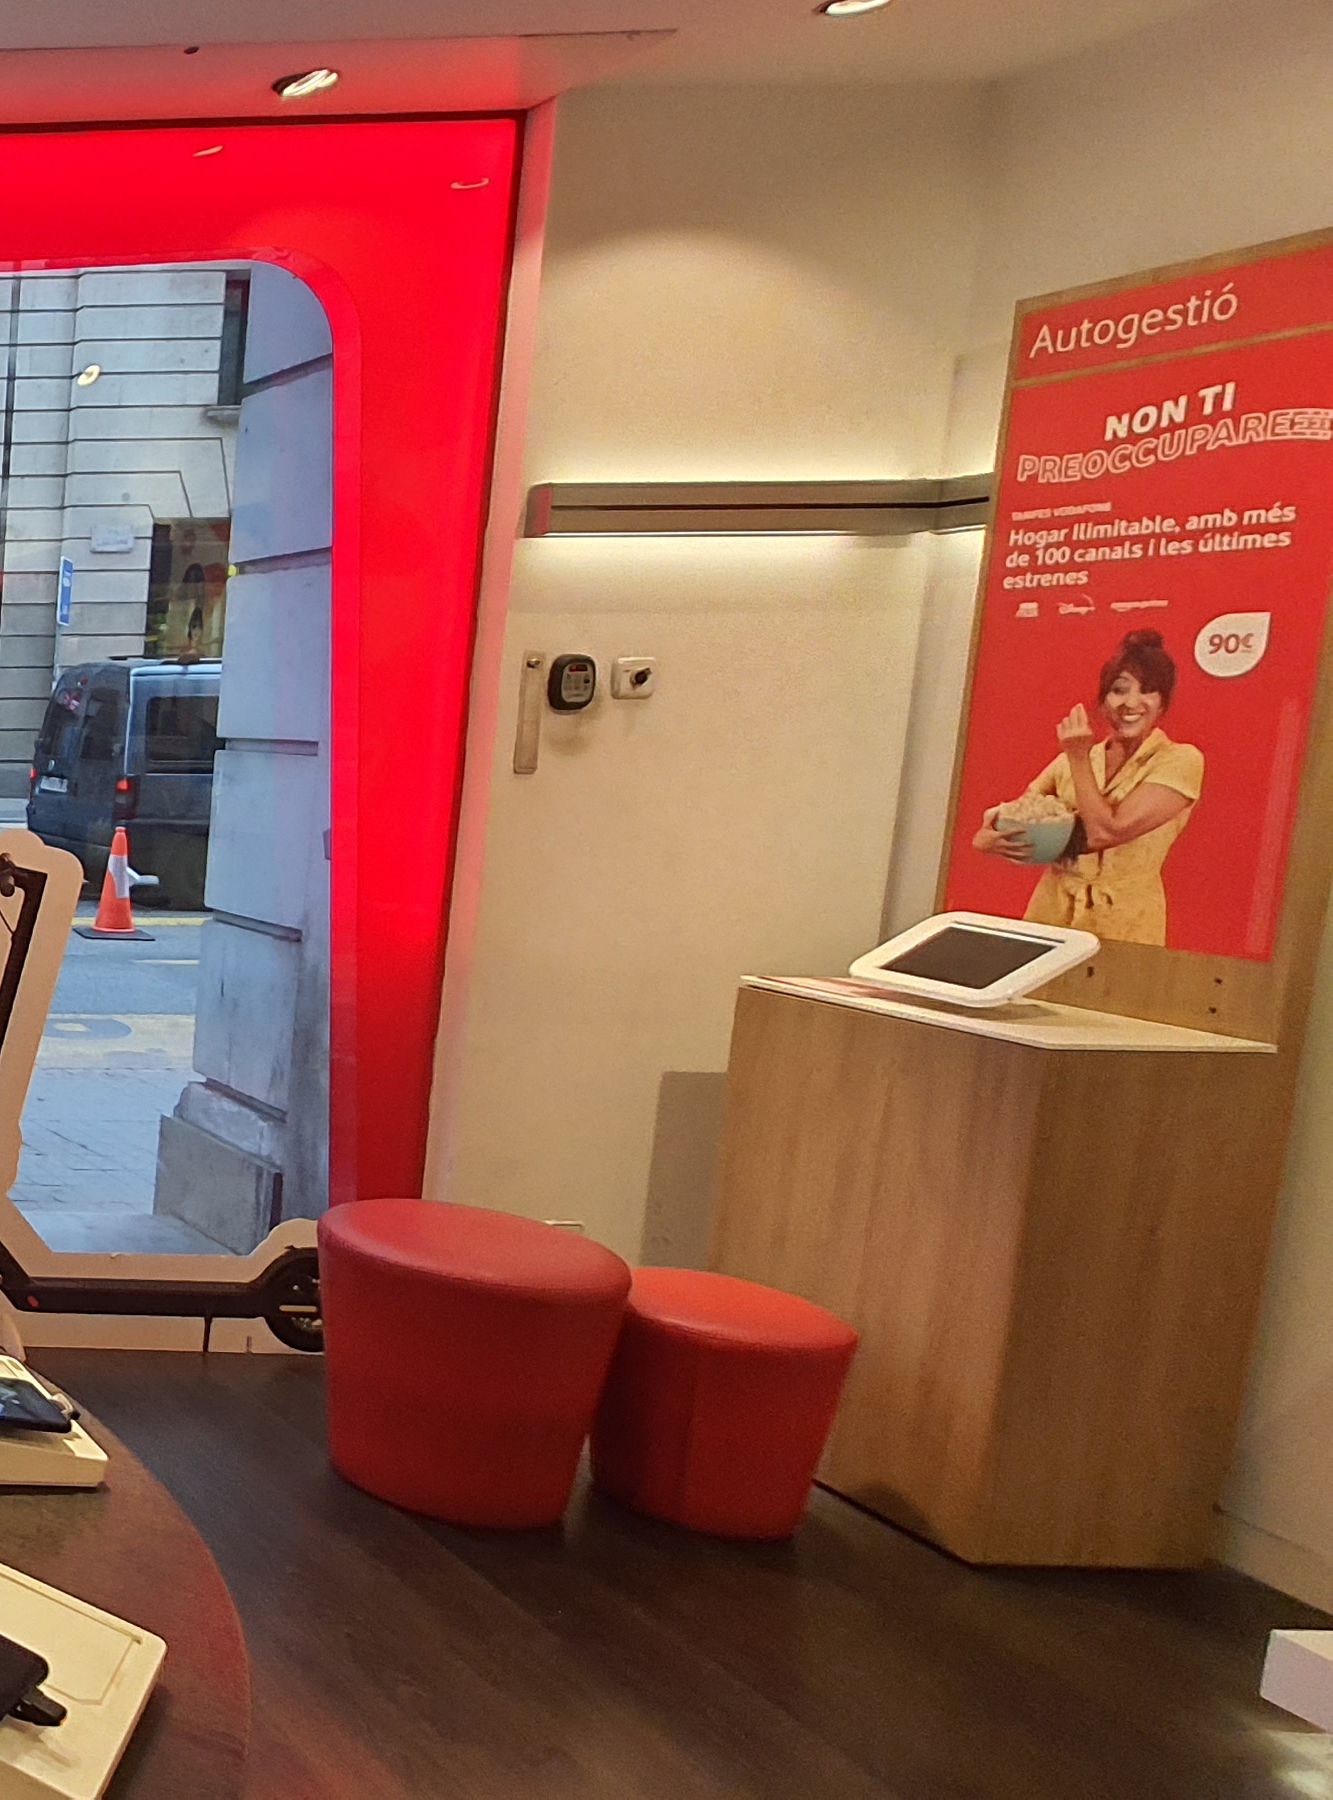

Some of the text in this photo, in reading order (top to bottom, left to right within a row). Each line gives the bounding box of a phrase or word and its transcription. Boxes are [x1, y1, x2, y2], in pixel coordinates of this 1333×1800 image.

[1029, 282, 1238, 358] Autogestió
[1104, 381, 1236, 441] NON TI
[1009, 526, 1069, 548] Hogar
[1185, 508, 1238, 531] amb
[1242, 501, 1297, 525] més
[1005, 550, 1030, 568] de
[1036, 546, 1071, 566] 100
[1073, 541, 1144, 563] canals
[1159, 535, 1195, 556] les
[1198, 530, 1293, 553] últimes
[1002, 569, 1089, 590] estrenes
[1208, 632, 1255, 655] 90€
